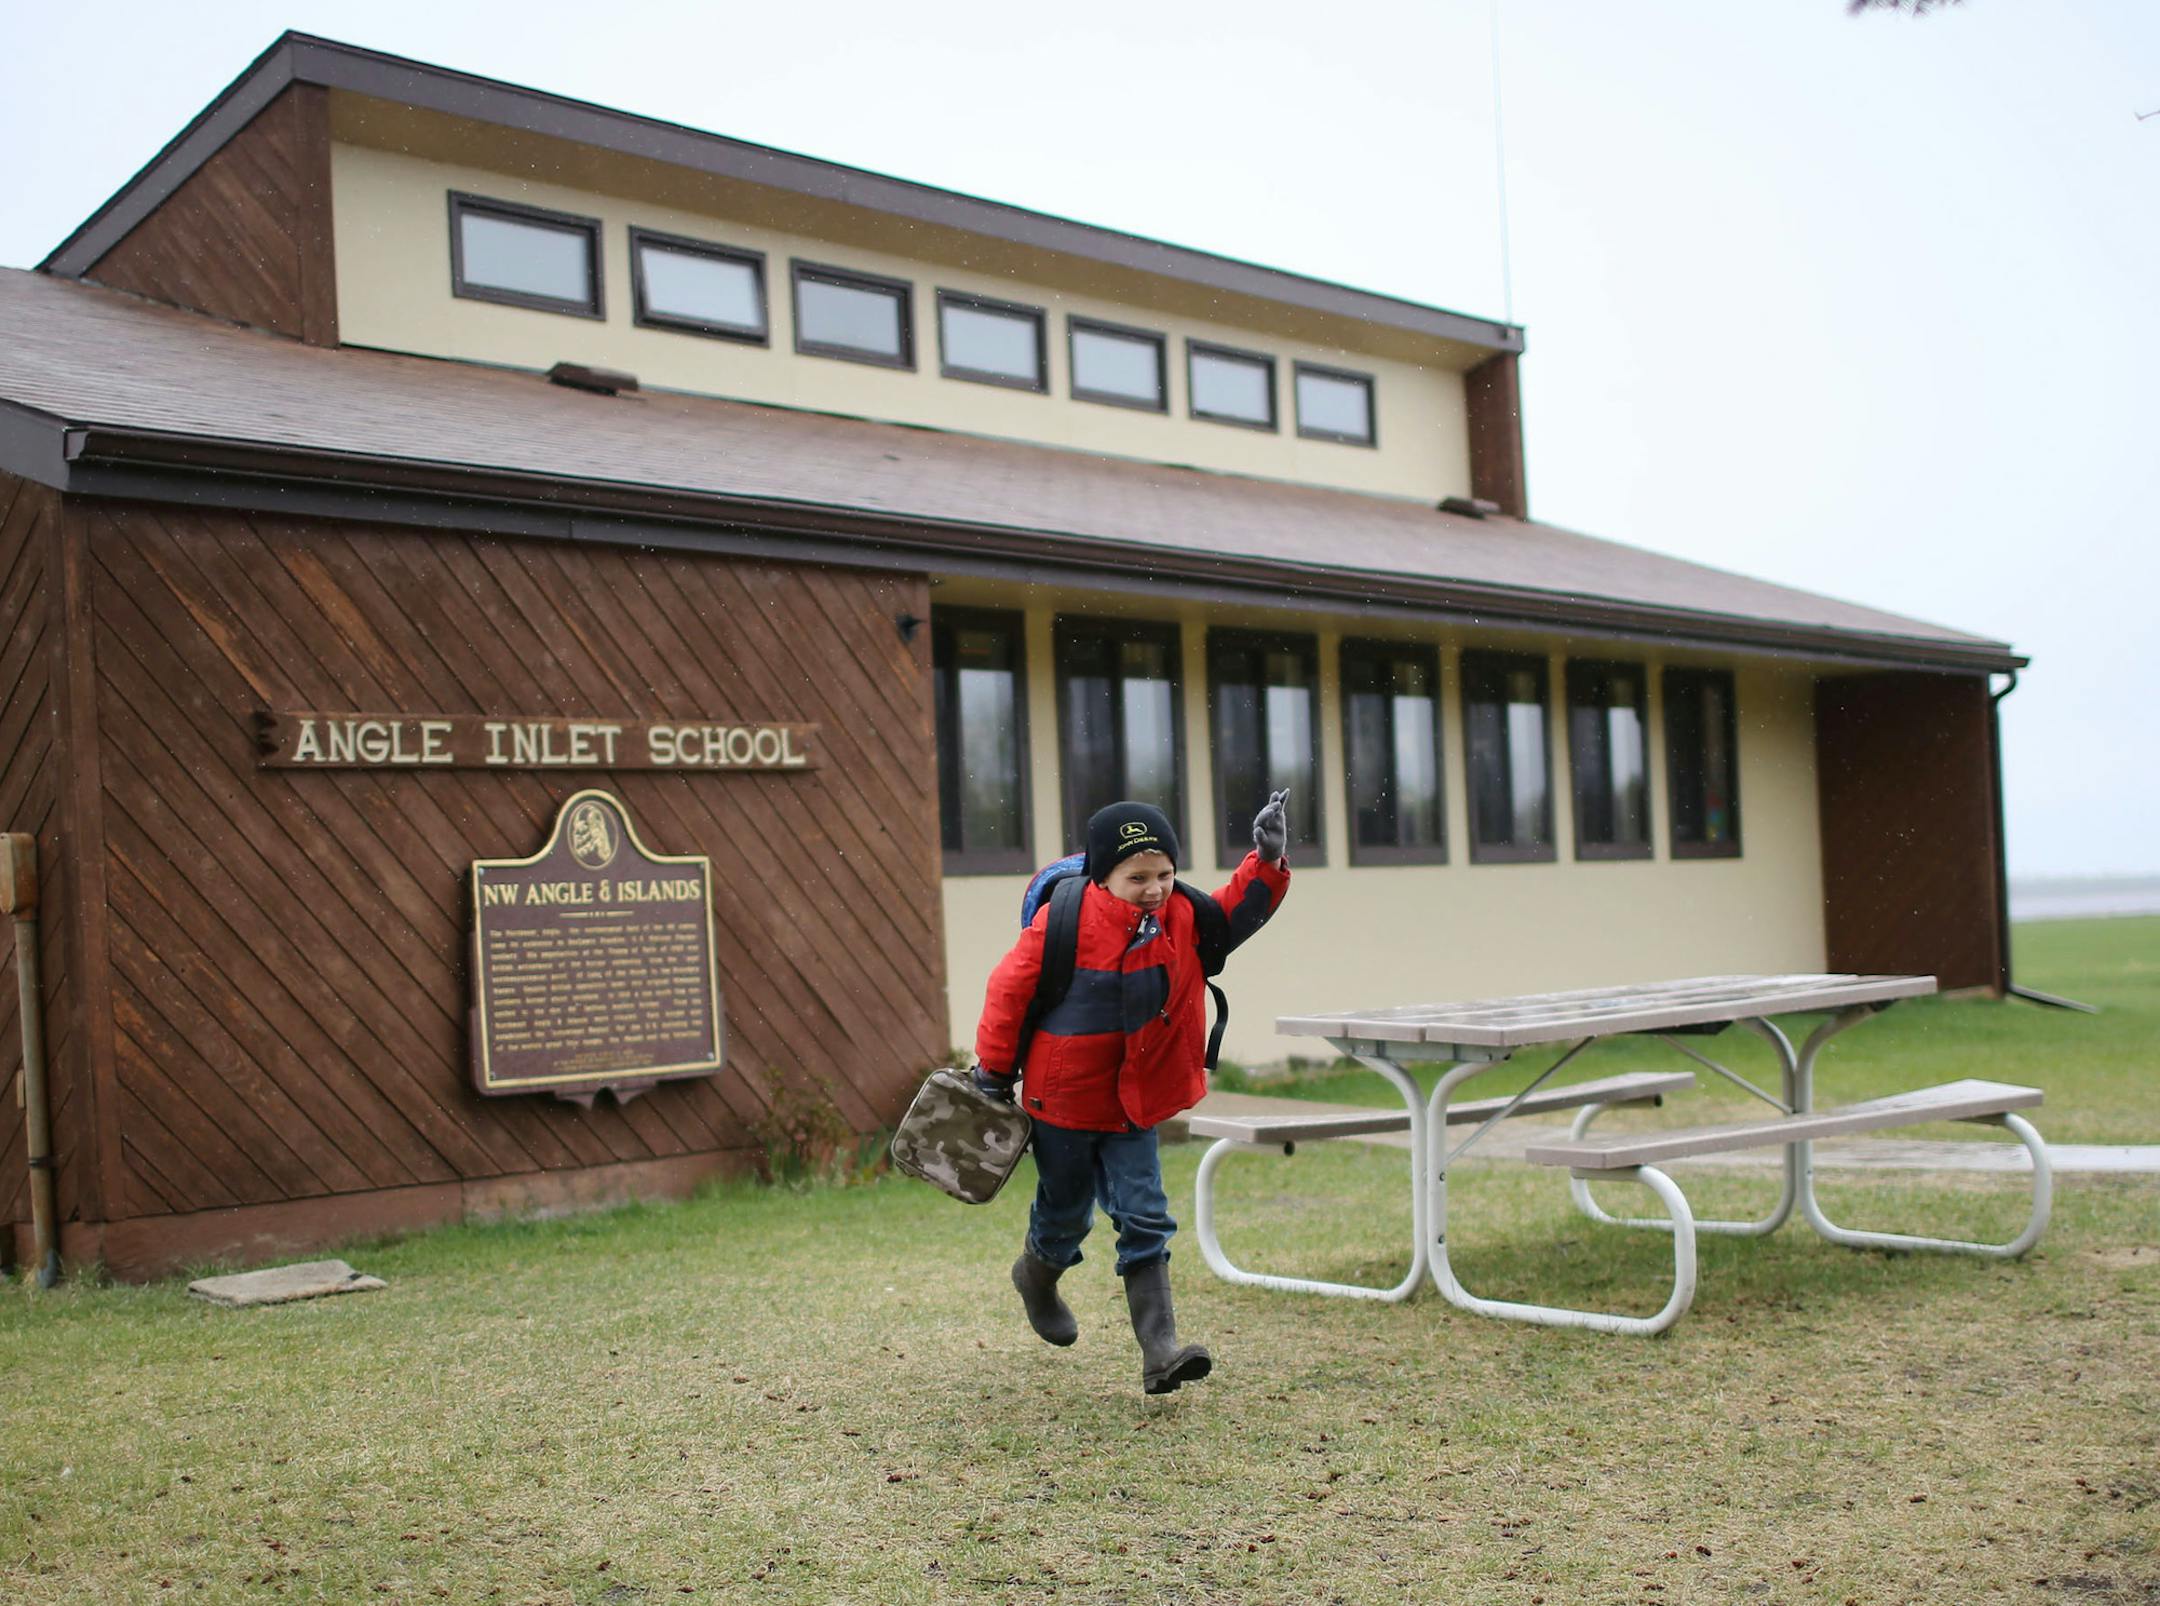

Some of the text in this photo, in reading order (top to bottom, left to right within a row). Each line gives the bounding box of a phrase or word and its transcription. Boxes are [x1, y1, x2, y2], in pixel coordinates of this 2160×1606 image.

[292, 721, 806, 765] ANGLE INLET SCHOOL
[484, 879, 701, 906] NW ANGLE & ISLANDS
